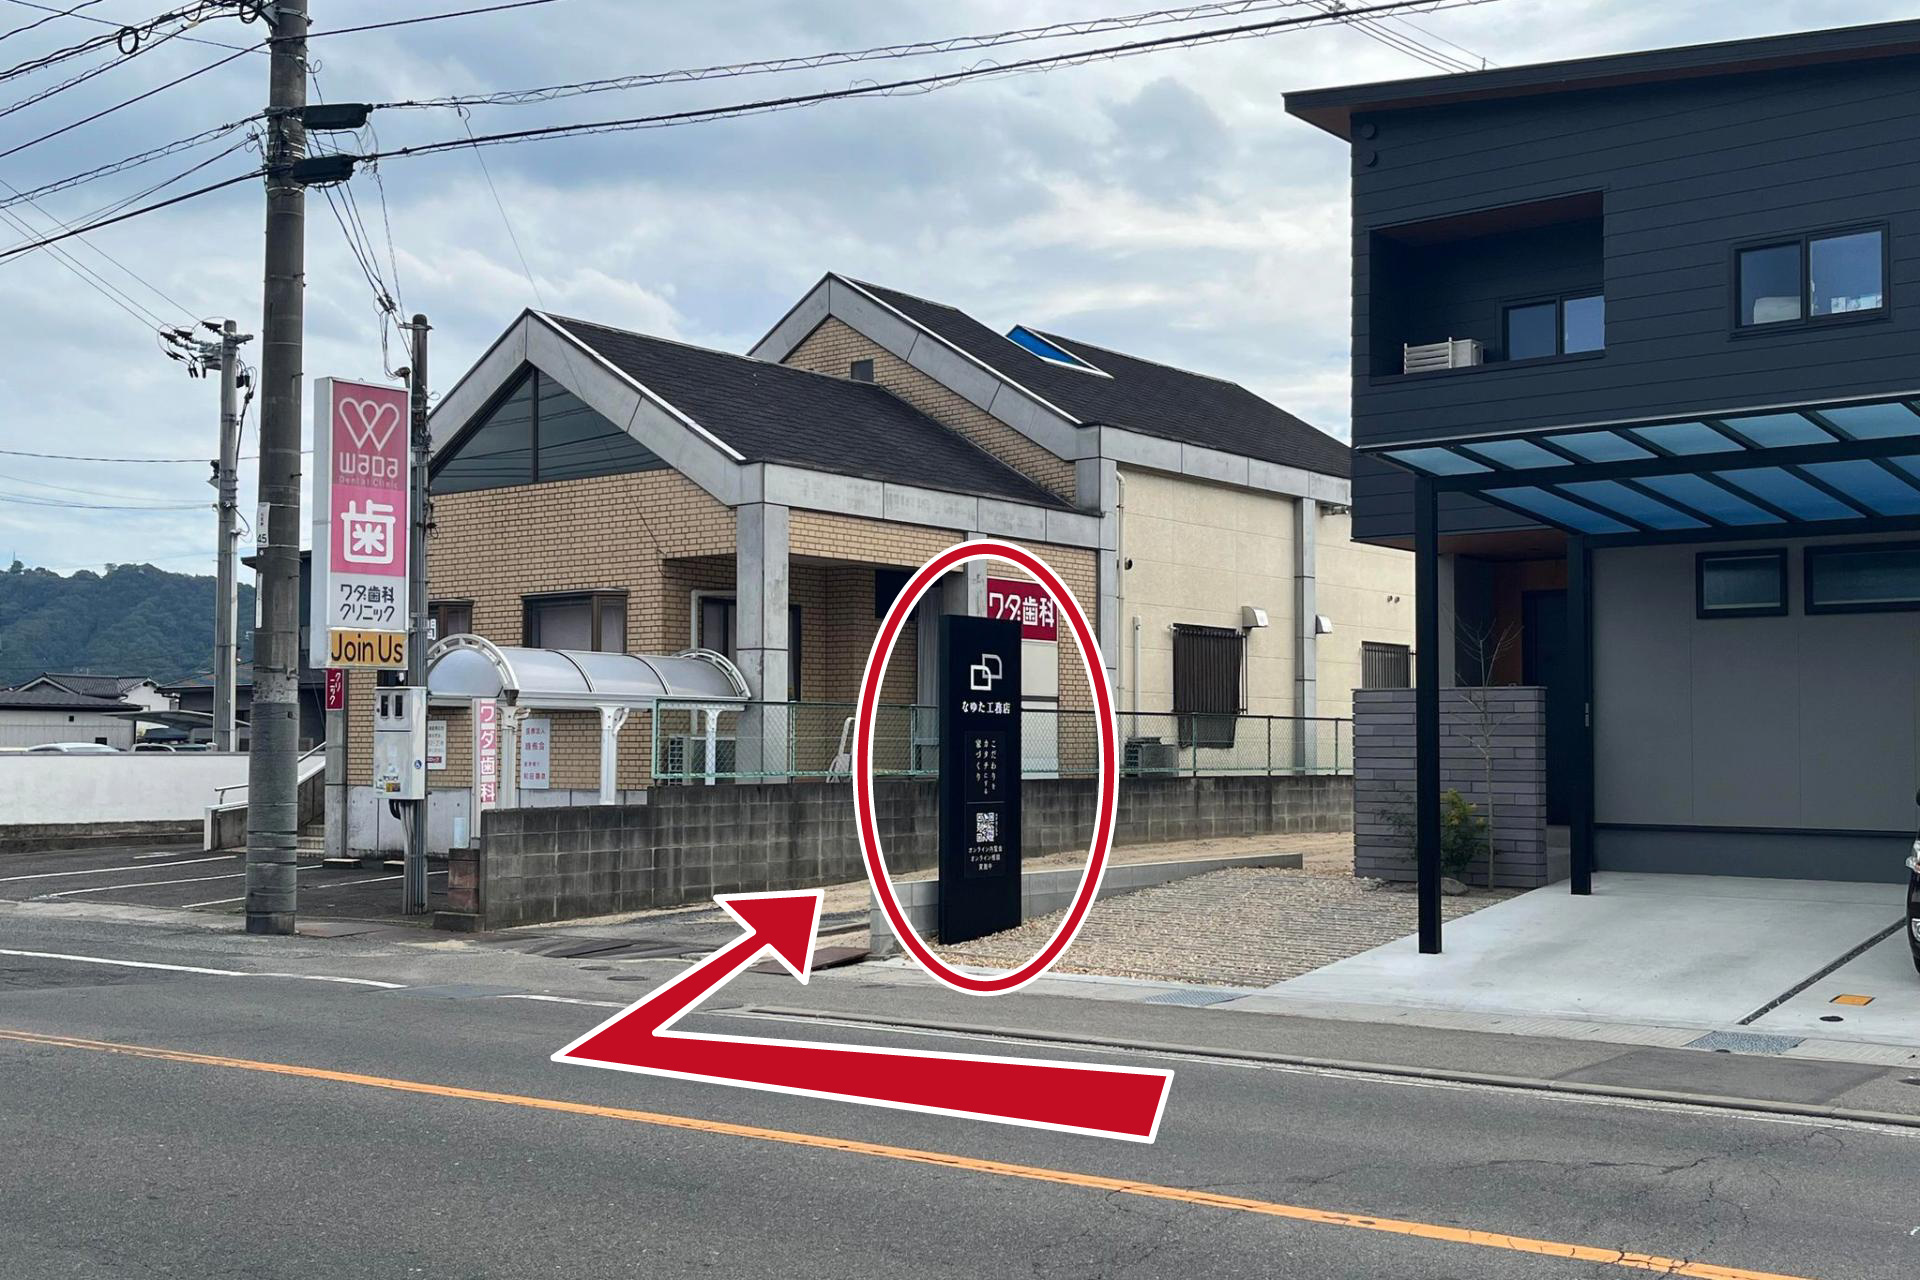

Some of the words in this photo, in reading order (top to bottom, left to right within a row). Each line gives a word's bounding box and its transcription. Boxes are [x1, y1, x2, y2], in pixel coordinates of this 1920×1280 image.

[257, 533, 267, 544] 45
[340, 499, 396, 564] 歯
[340, 584, 395, 603] ワダ歯科
[340, 604, 395, 622] クリニック
[988, 592, 1055, 628] ワダ歯科
[331, 633, 374, 663] Join
[378, 635, 403, 664] Us
[961, 700, 1011, 714] なゆた工務店
[480, 705, 496, 803] ワダ歯科
